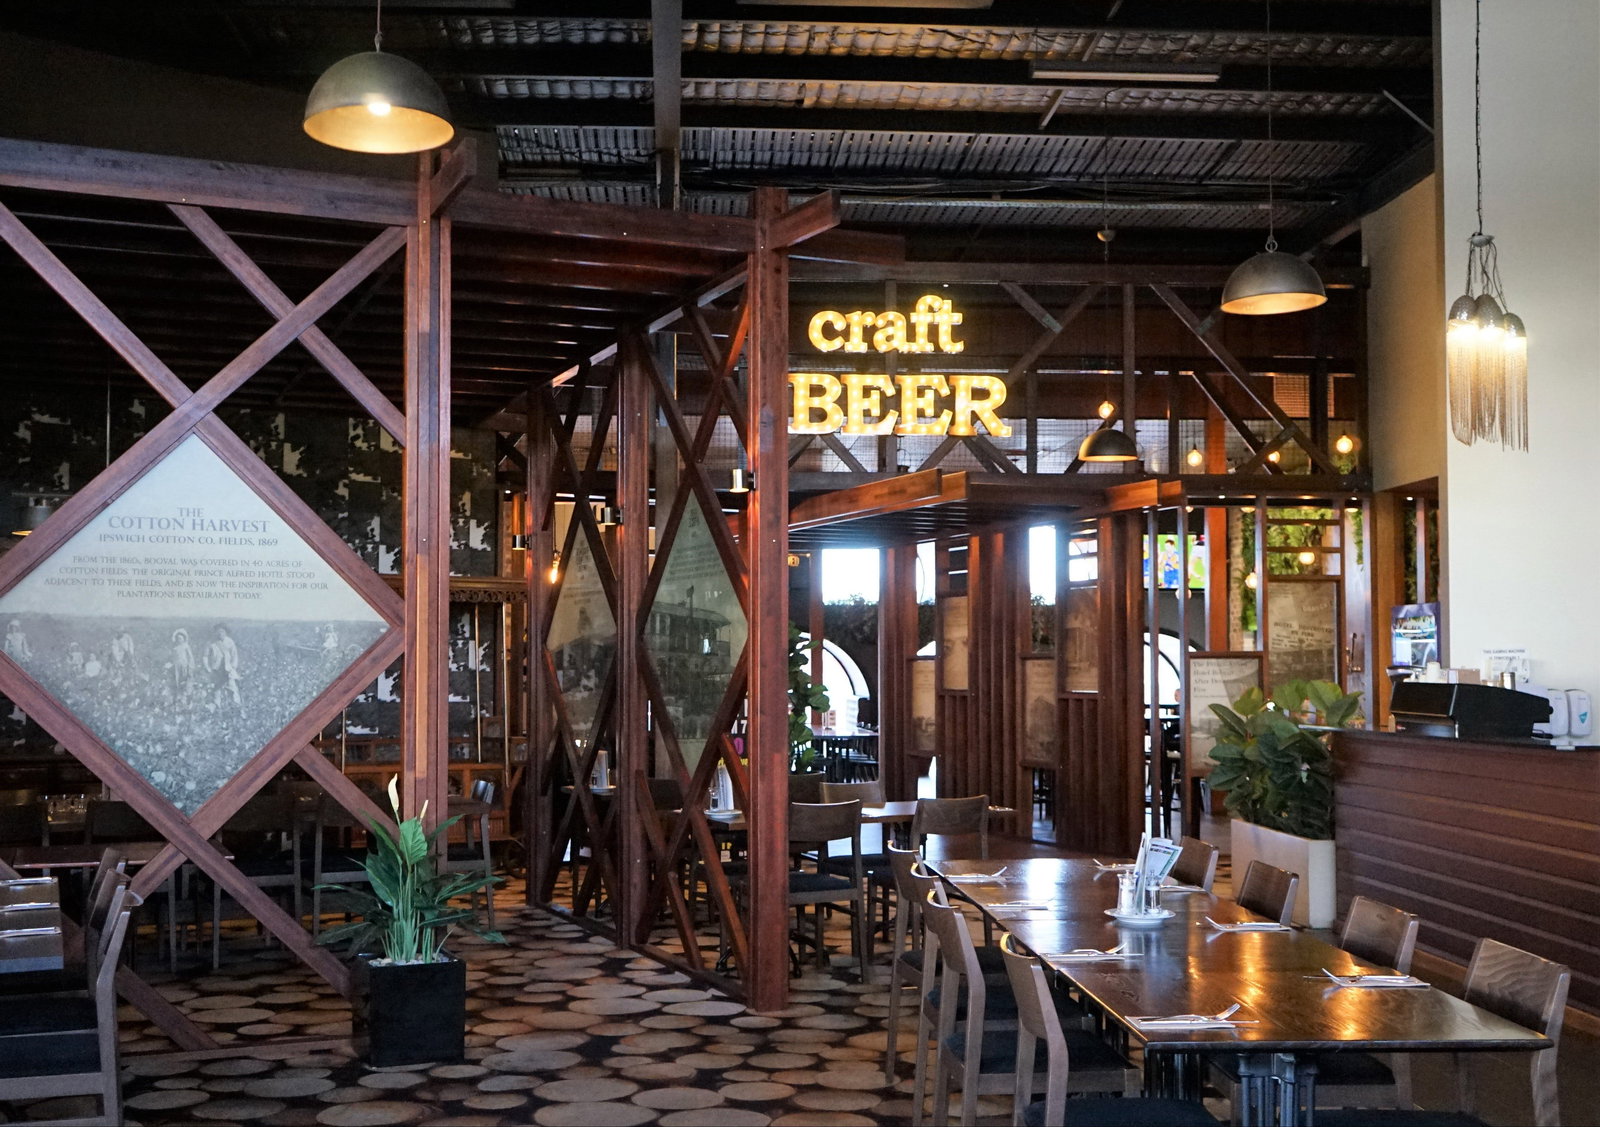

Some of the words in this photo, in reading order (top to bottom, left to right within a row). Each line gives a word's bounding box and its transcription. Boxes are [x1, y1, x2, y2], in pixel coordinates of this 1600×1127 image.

[808, 294, 964, 353] craft
[788, 373, 1012, 437] BEER
[177, 507, 204, 517] THE
[108, 515, 185, 531] COTTON
[192, 518, 270, 533] HARVEST
[99, 533, 145, 543] IPSWICH
[150, 535, 194, 545] COTTON
[198, 536, 215, 545] CO.
[73, 555, 98, 563] FROM
[101, 556, 117, 564] THE
[180, 558, 197, 566] WAS
[200, 558, 238, 566] COVERED
[241, 559, 249, 567] IN
[59, 566, 98, 574] COTTON
[151, 568, 191, 577] ORIGINAL
[226, 570, 255, 578] ALFRED
[258, 570, 283, 578] HOTEL
[286, 571, 315, 579] STOOD
[44, 577, 88, 586] ADJACENT
[92, 578, 105, 586] TO
[107, 578, 132, 587] THESE
[164, 580, 184, 588] AND
[186, 580, 194, 588] IS
[238, 581, 289, 590] INSPIRATION
[117, 590, 175, 599] PLANTATIONS
[177, 591, 230, 599] RESTAURANT
